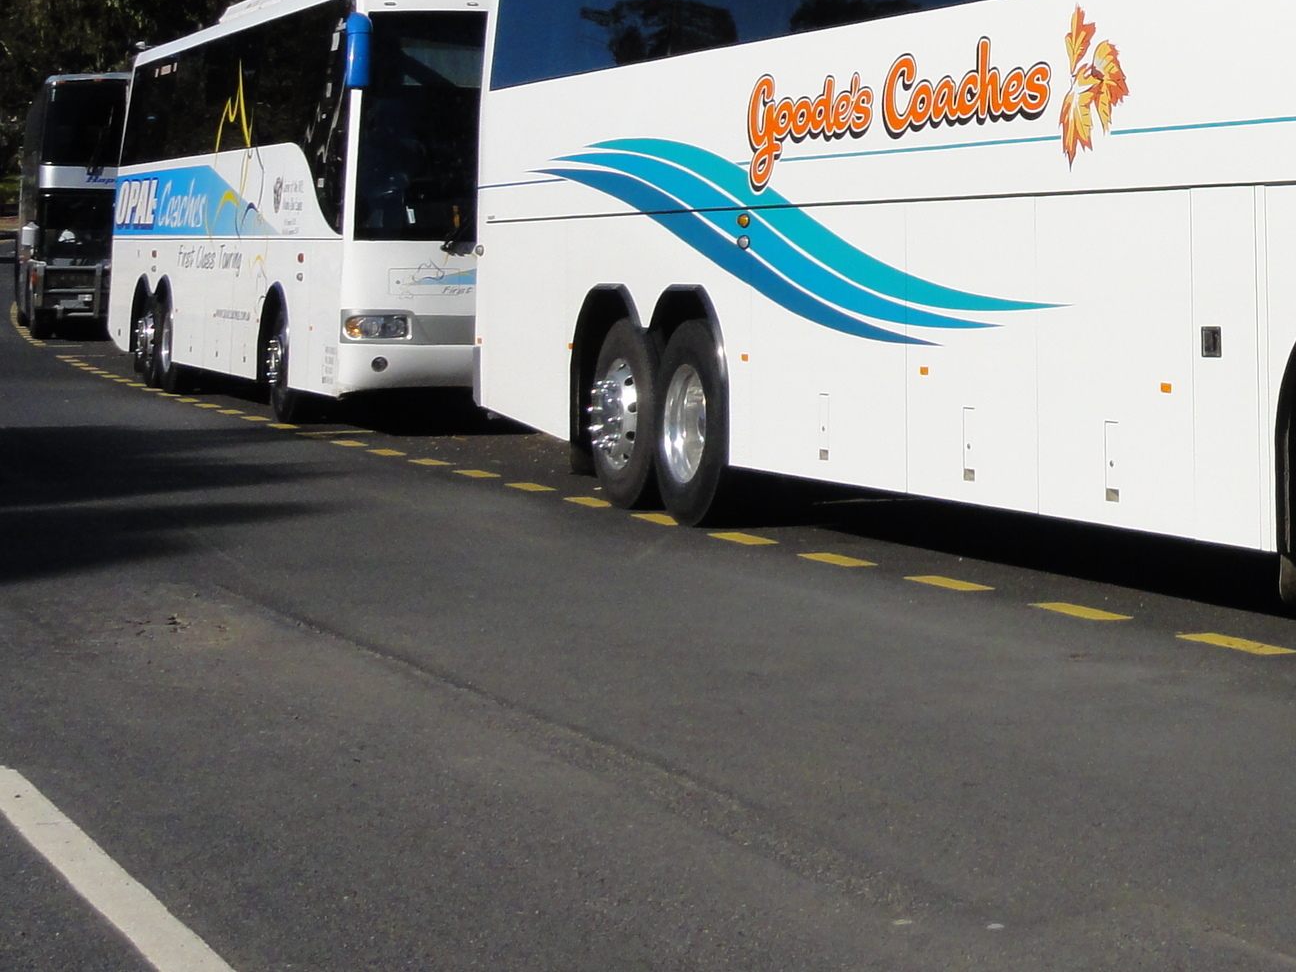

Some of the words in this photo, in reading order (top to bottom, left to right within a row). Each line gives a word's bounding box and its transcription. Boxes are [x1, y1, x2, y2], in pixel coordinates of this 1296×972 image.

[748, 71, 873, 194] Goode's
[882, 35, 1051, 139] Coaches
[116, 177, 158, 230] OPAL
[158, 177, 207, 228] Coaches
[177, 244, 196, 269] First
[197, 245, 216, 270] Class
[217, 244, 243, 277] Touring
